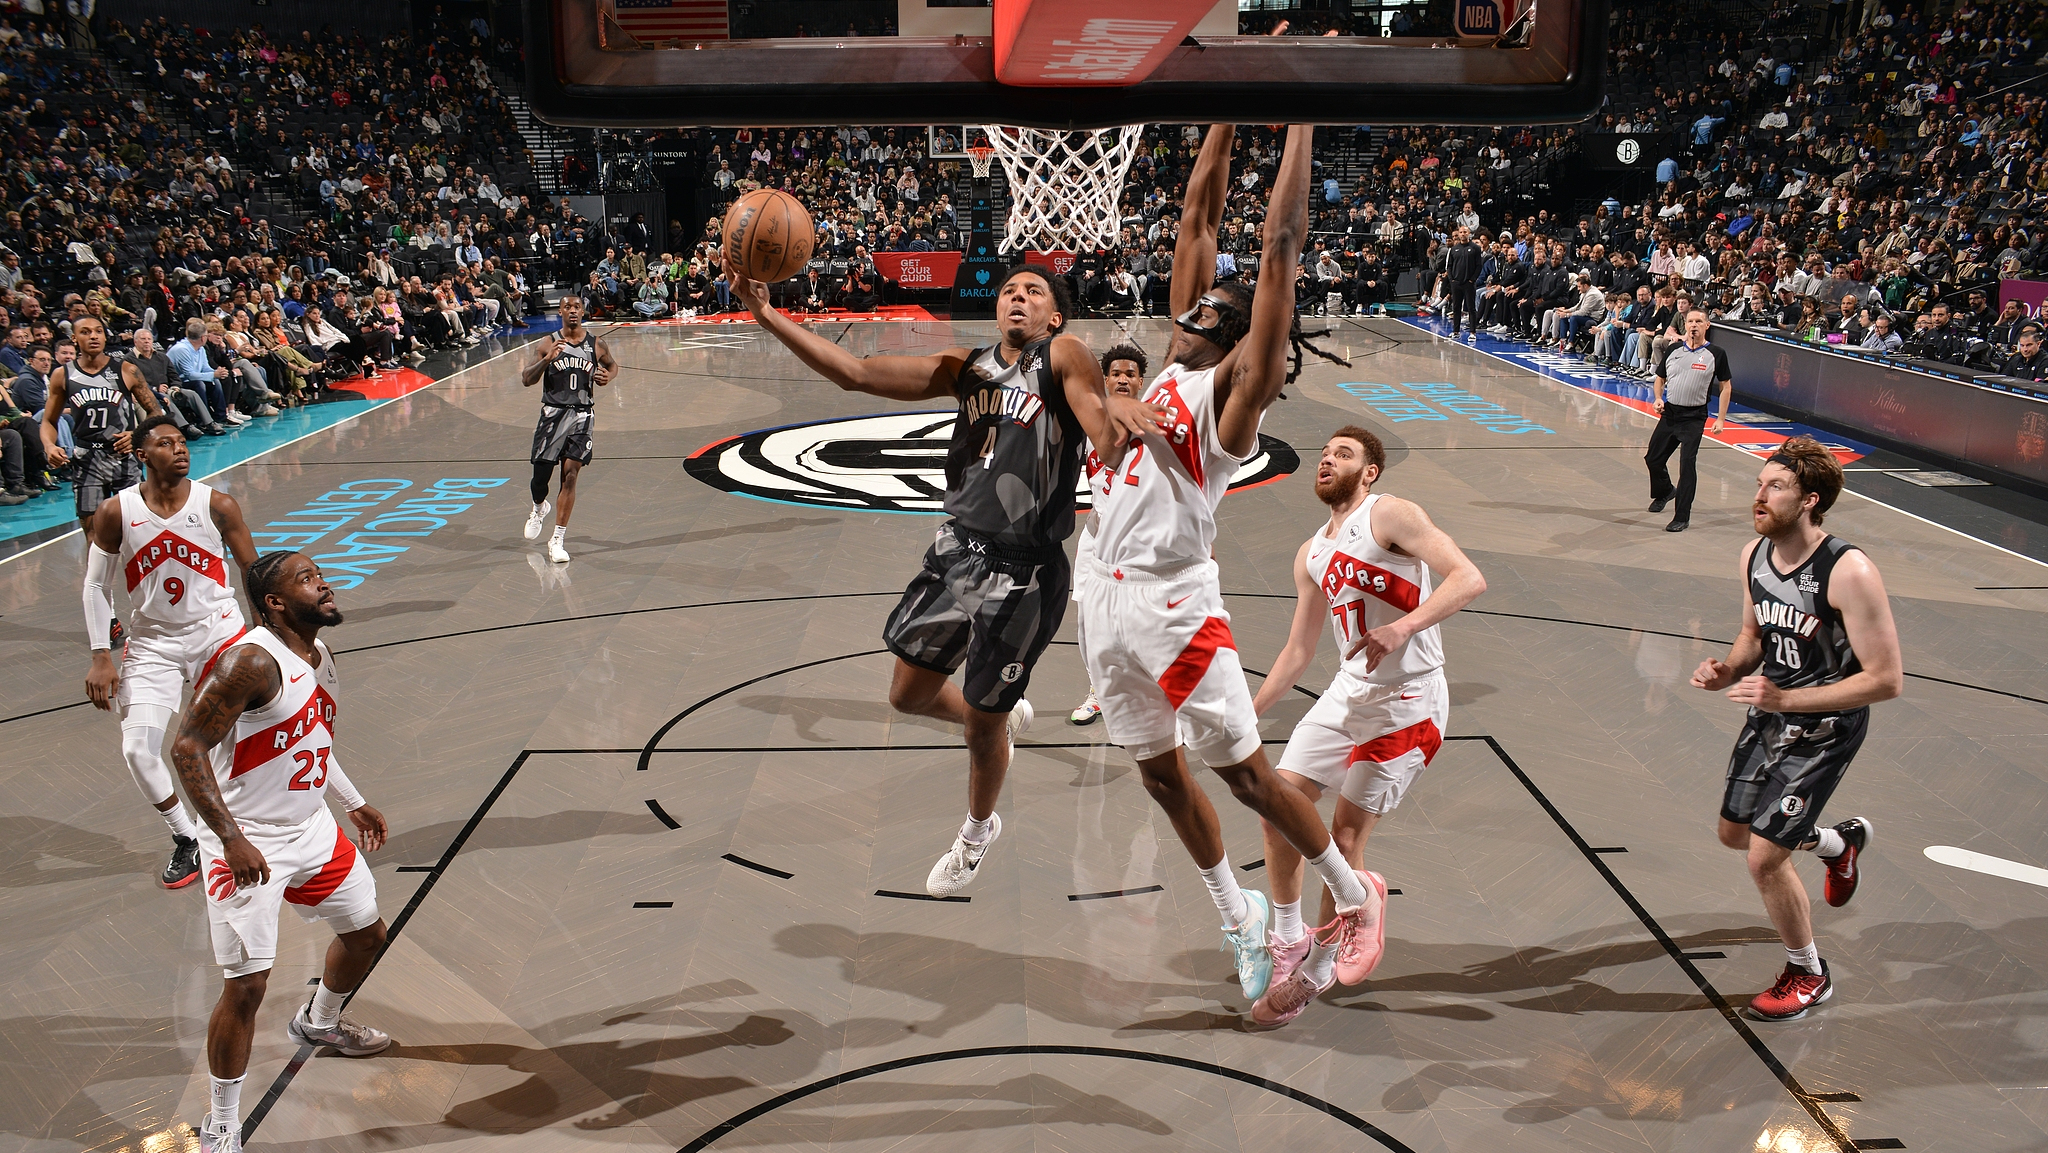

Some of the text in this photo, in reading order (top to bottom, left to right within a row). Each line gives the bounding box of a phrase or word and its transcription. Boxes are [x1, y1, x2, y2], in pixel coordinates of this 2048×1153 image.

[1464, 5, 1493, 28] NBA
[730, 206, 757, 266] Wilson
[900, 259, 921, 267] GET
[900, 266, 931, 274] YOUR
[1054, 257, 1074, 265] GET
[1054, 265, 1070, 274] YO
[900, 274, 932, 282] GUIDE
[959, 288, 997, 298] BARCLA
[553, 356, 594, 373] BROOKLYN
[569, 373, 578, 391] 0
[70, 387, 124, 408] BROOKLYN
[966, 387, 1045, 429] BROOKLYN
[1336, 381, 1450, 423] CENTER
[1400, 381, 1557, 435] BARCLAYS
[1869, 384, 1907, 414] Kilian
[86, 407, 108, 429] 27
[978, 426, 998, 470] 4
[1123, 437, 1145, 487] 2
[1326, 560, 1388, 603] APTORS
[1798, 584, 1820, 594] GUIDE
[1799, 573, 1814, 581] GET
[1799, 579, 1820, 588] YOUR
[163, 576, 185, 607] 9
[1331, 598, 1368, 642] 77
[1753, 600, 1822, 640] ROOKLYN
[1770, 632, 1802, 670] 26
[273, 697, 337, 750] RAPTO
[287, 746, 331, 791] 23
